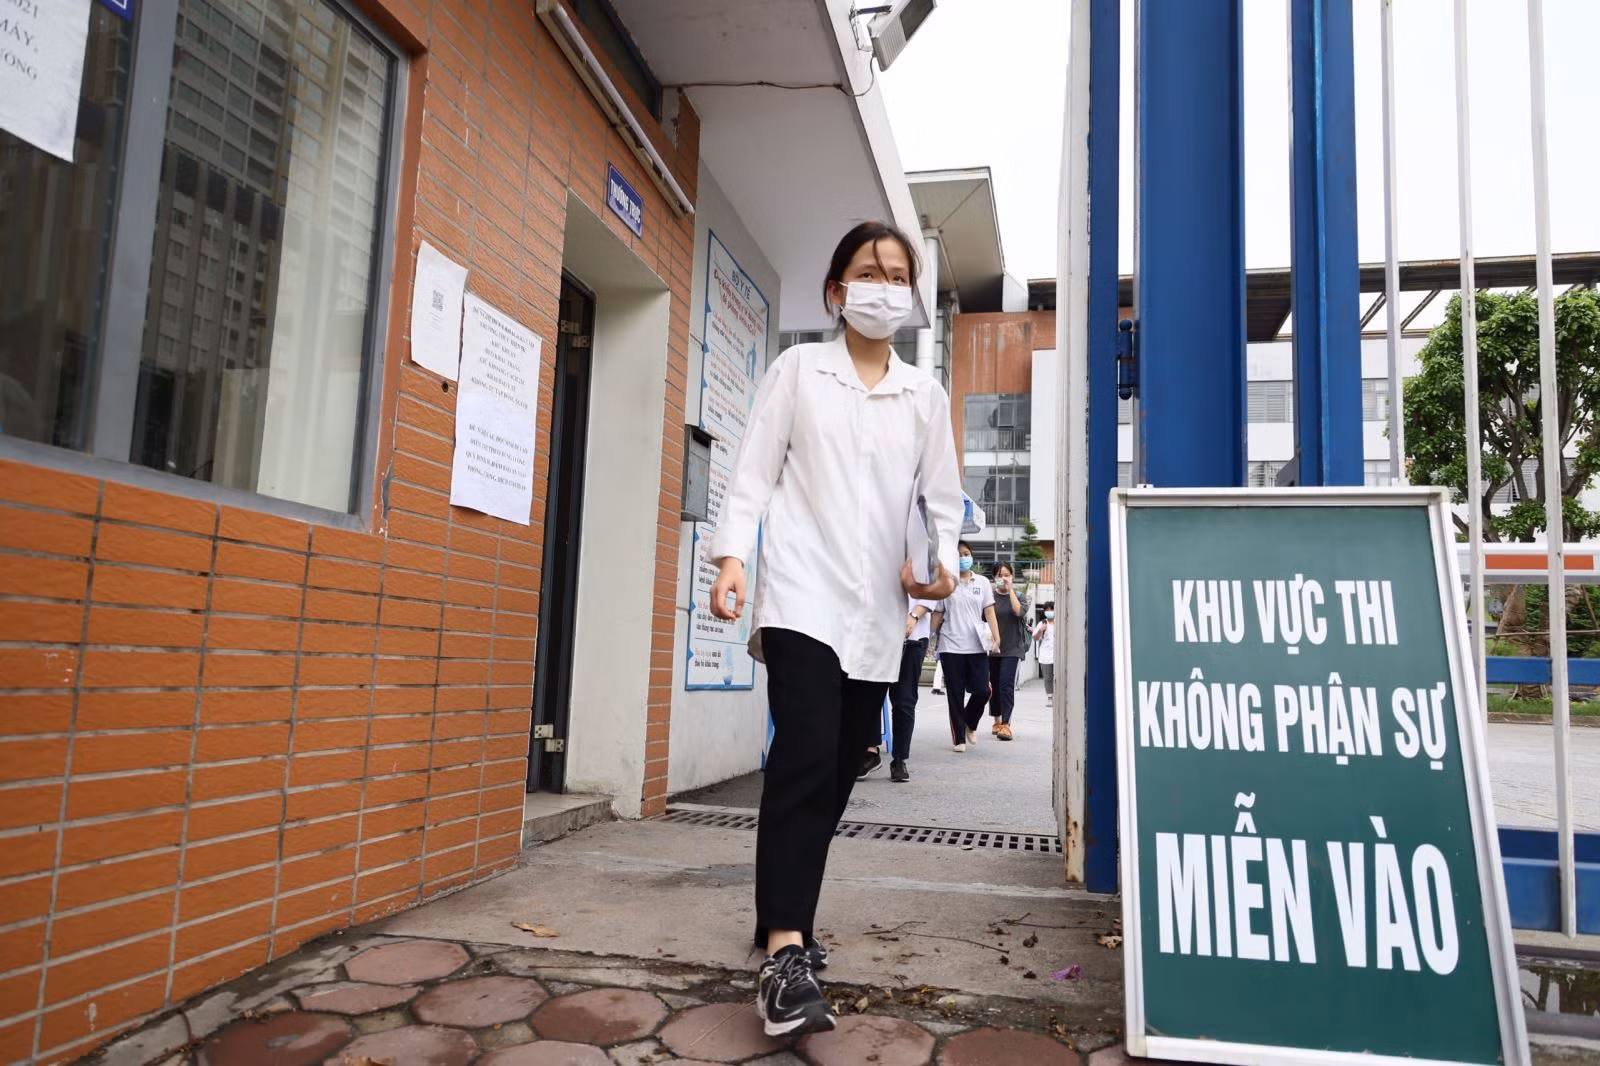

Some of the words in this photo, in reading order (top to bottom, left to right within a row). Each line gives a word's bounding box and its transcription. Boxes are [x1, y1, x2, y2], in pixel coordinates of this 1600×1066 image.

[1172, 580, 1244, 643] KHU
[1253, 573, 1328, 655] VỰC
[1335, 580, 1398, 645] THI
[1138, 667, 1265, 753] KHÔNG
[1273, 672, 1383, 766] PHẬN
[1391, 682, 1447, 770] SỰ
[1155, 791, 1317, 965] MIỄN
[1327, 815, 1460, 976] VÀO
